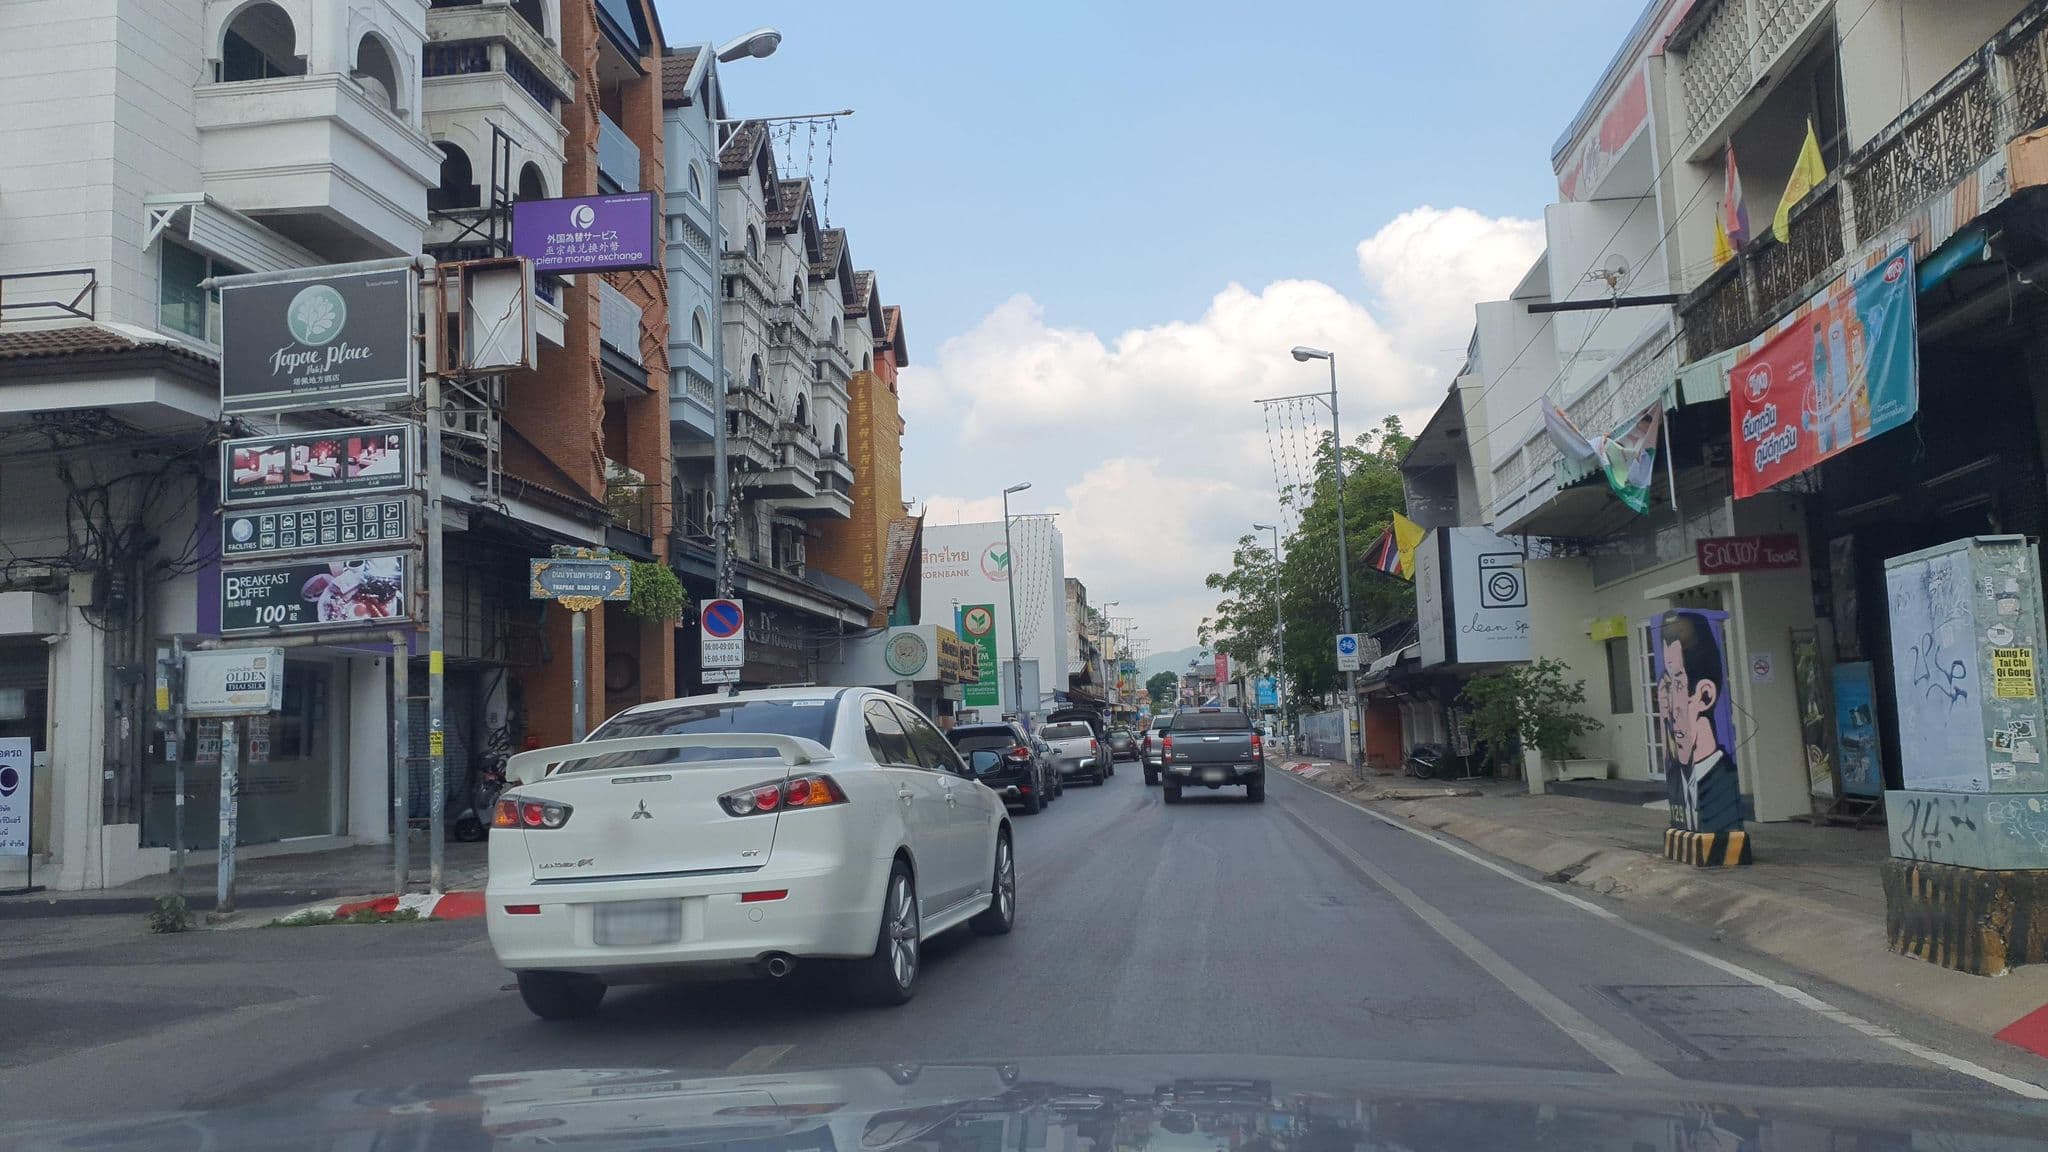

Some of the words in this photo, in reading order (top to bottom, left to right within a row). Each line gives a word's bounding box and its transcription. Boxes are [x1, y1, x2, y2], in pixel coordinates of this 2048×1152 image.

[547, 230, 618, 244] 外国為替サービス
[565, 253, 596, 265] money
[598, 250, 643, 262] exchange
[269, 342, 322, 376] Tapae
[324, 342, 373, 372] Place
[228, 542, 257, 551] FACILITIES
[604, 570, 611, 580] 3
[256, 604, 286, 623] 100
[1994, 649, 2018, 658] Kung
[2020, 649, 2030, 657] Fu
[2000, 659, 2012, 667] Tai
[2013, 659, 2027, 667] Chi
[226, 671, 266, 683] OLDEN
[1997, 668, 2007, 677] Qi
[2008, 668, 2031, 678] Gong
